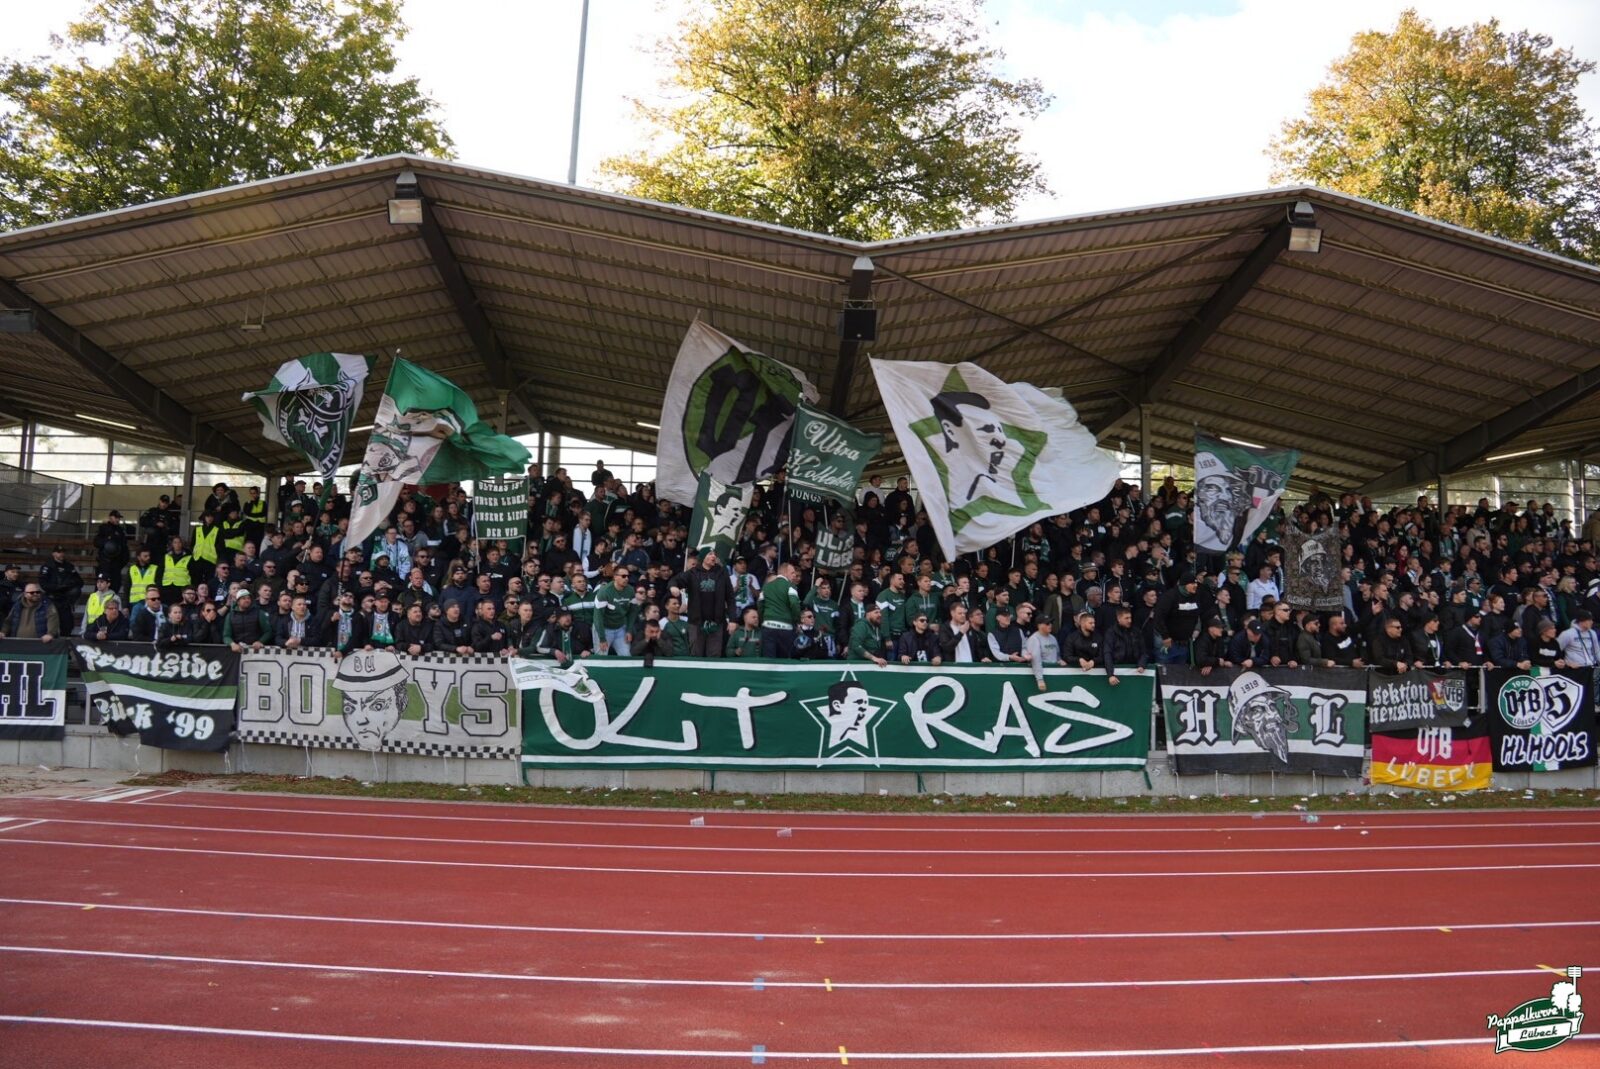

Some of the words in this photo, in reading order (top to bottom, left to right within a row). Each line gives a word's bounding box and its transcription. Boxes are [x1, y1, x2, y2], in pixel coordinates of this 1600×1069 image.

[804, 421, 860, 461] Ultra
[478, 481, 509, 492] ULTRAS
[475, 511, 504, 522] UNSERE
[486, 527, 502, 537] DER
[75, 645, 223, 681] Frontside
[353, 655, 376, 673] BU
[1241, 679, 1259, 693] 1919
[1511, 680, 1530, 689] 1919
[1503, 688, 1541, 716] VfB
[1417, 727, 1452, 762] VfB
[1527, 731, 1588, 764] HOOLS
[1386, 756, 1475, 788] LÜBECK
